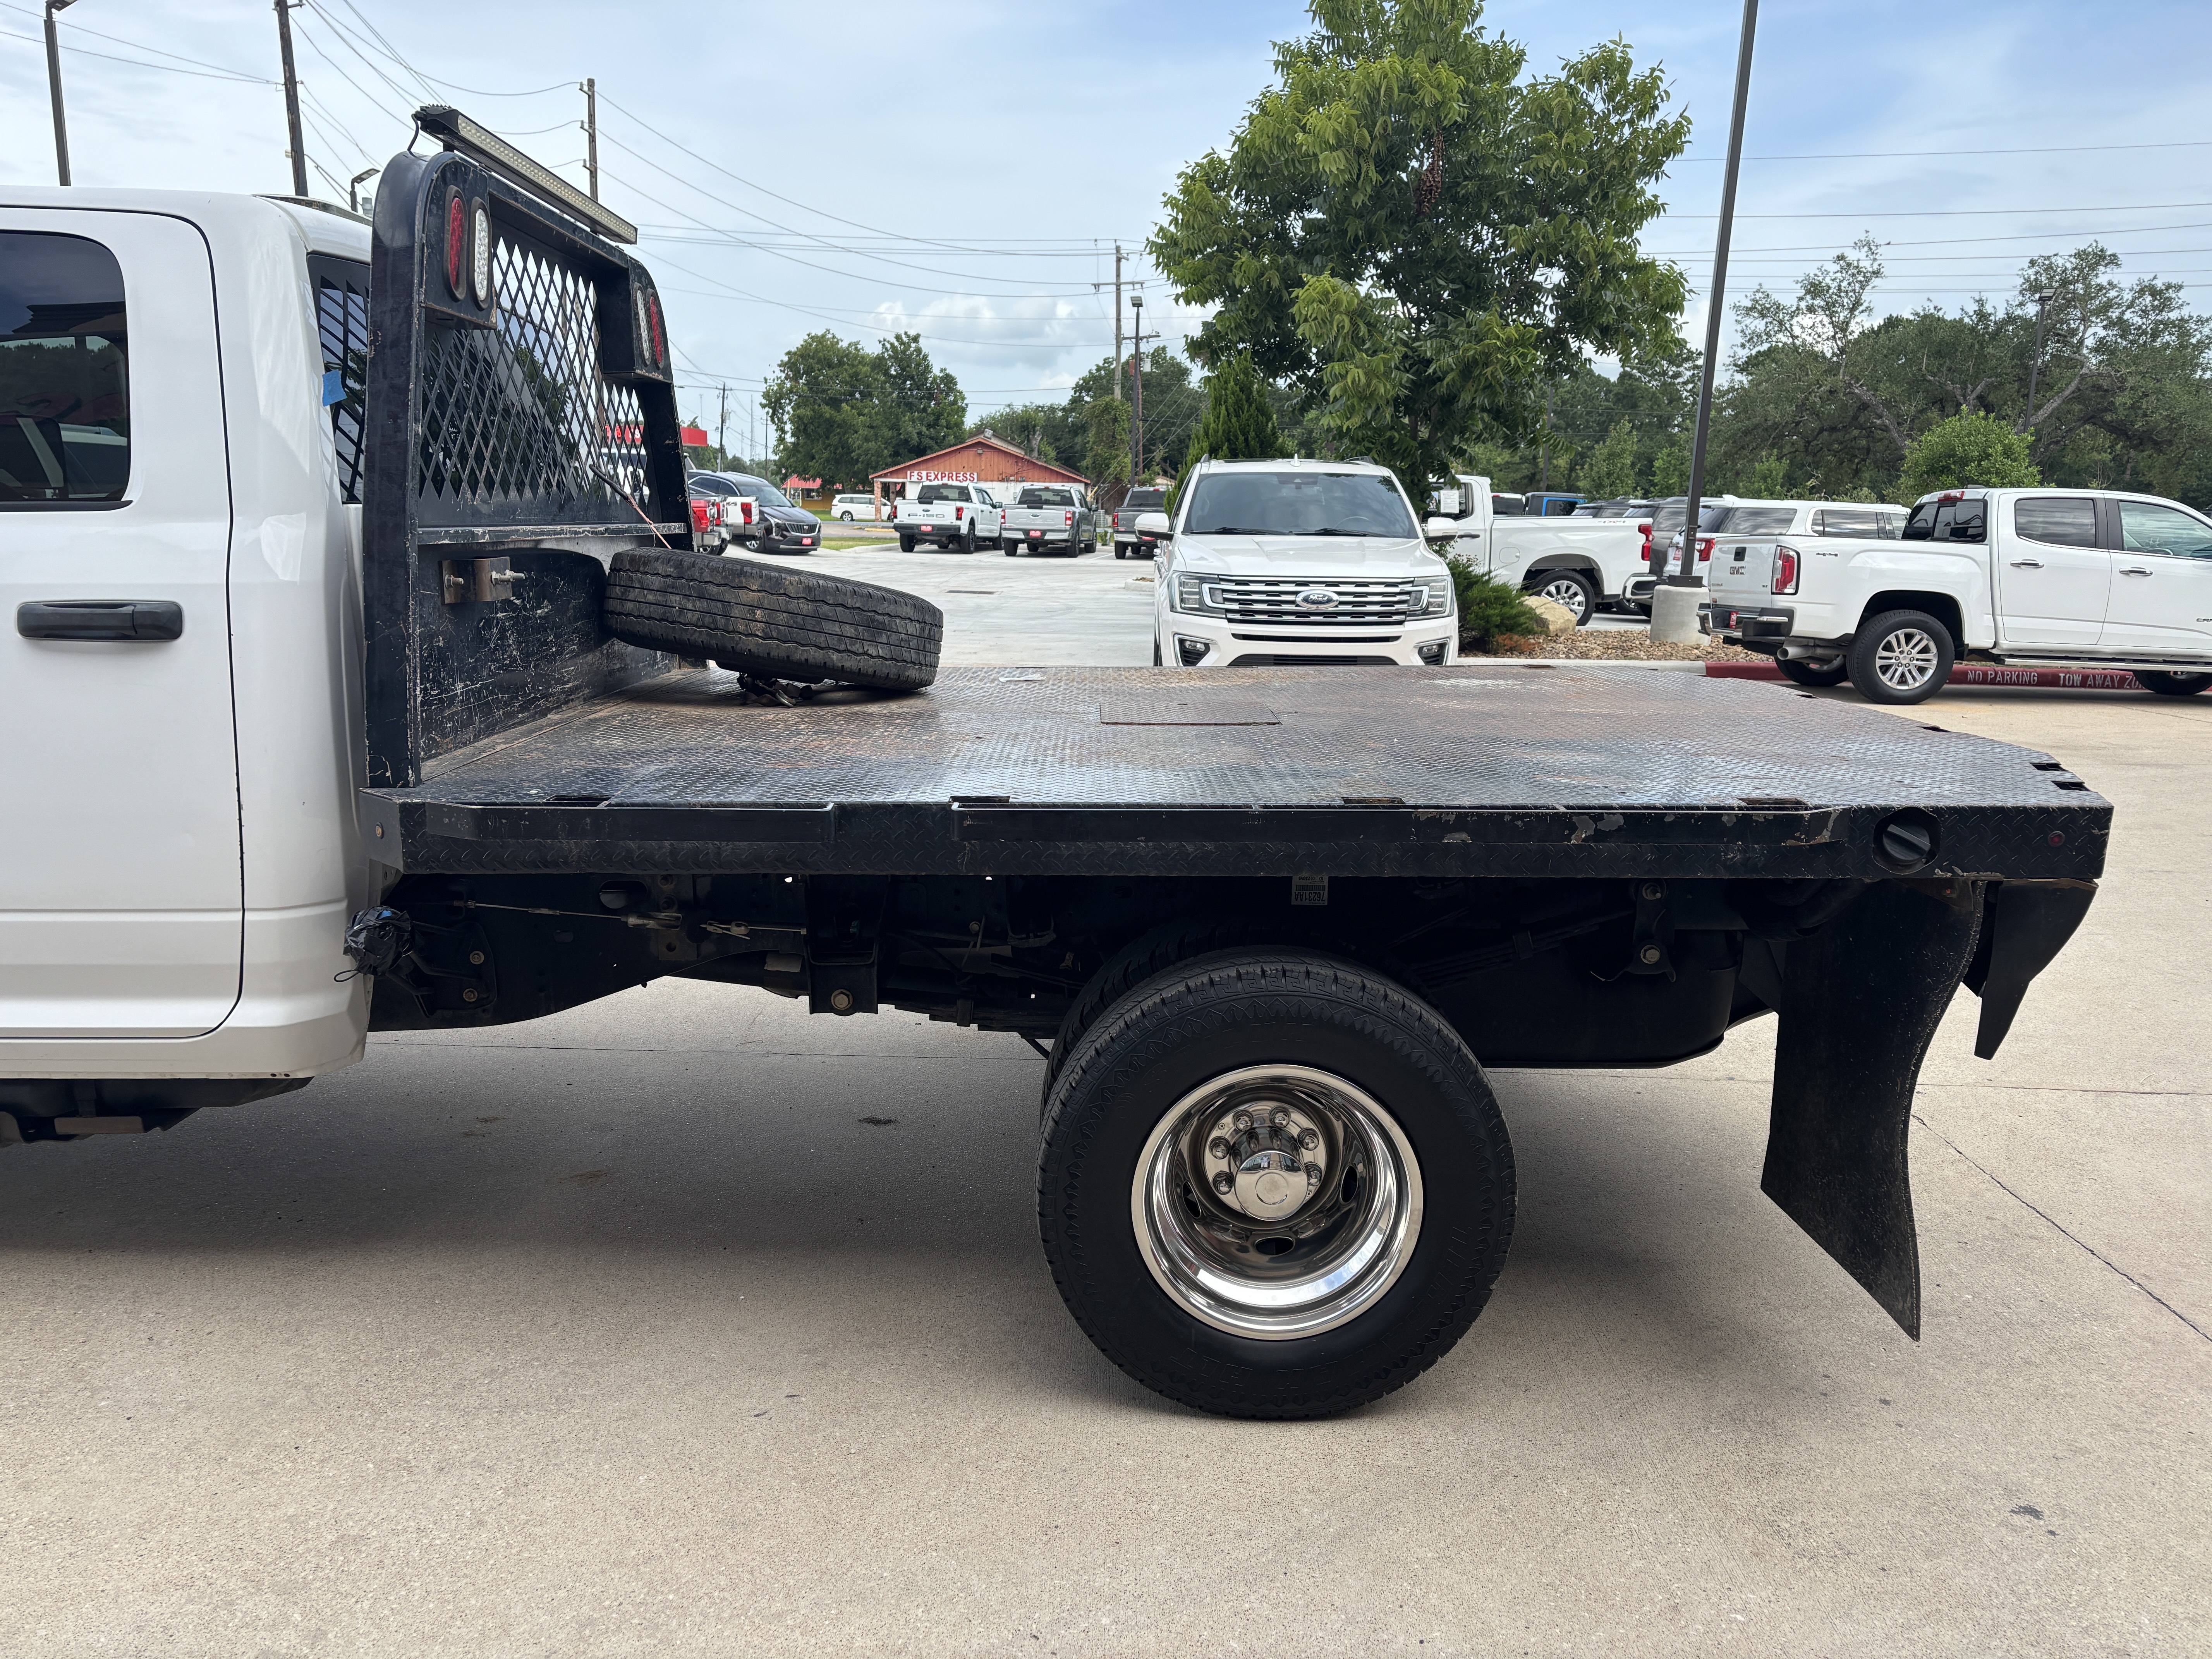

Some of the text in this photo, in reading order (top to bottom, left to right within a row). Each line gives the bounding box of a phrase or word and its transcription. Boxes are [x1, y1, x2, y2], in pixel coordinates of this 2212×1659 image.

[926, 472, 975, 482] EXPRESS
[1729, 566, 1746, 575] GMC
[1309, 594, 1328, 603] Ford
[1967, 670, 2145, 689] NO PARKING TOW AWAY ZO
[1294, 891, 1326, 902] 76231AA
